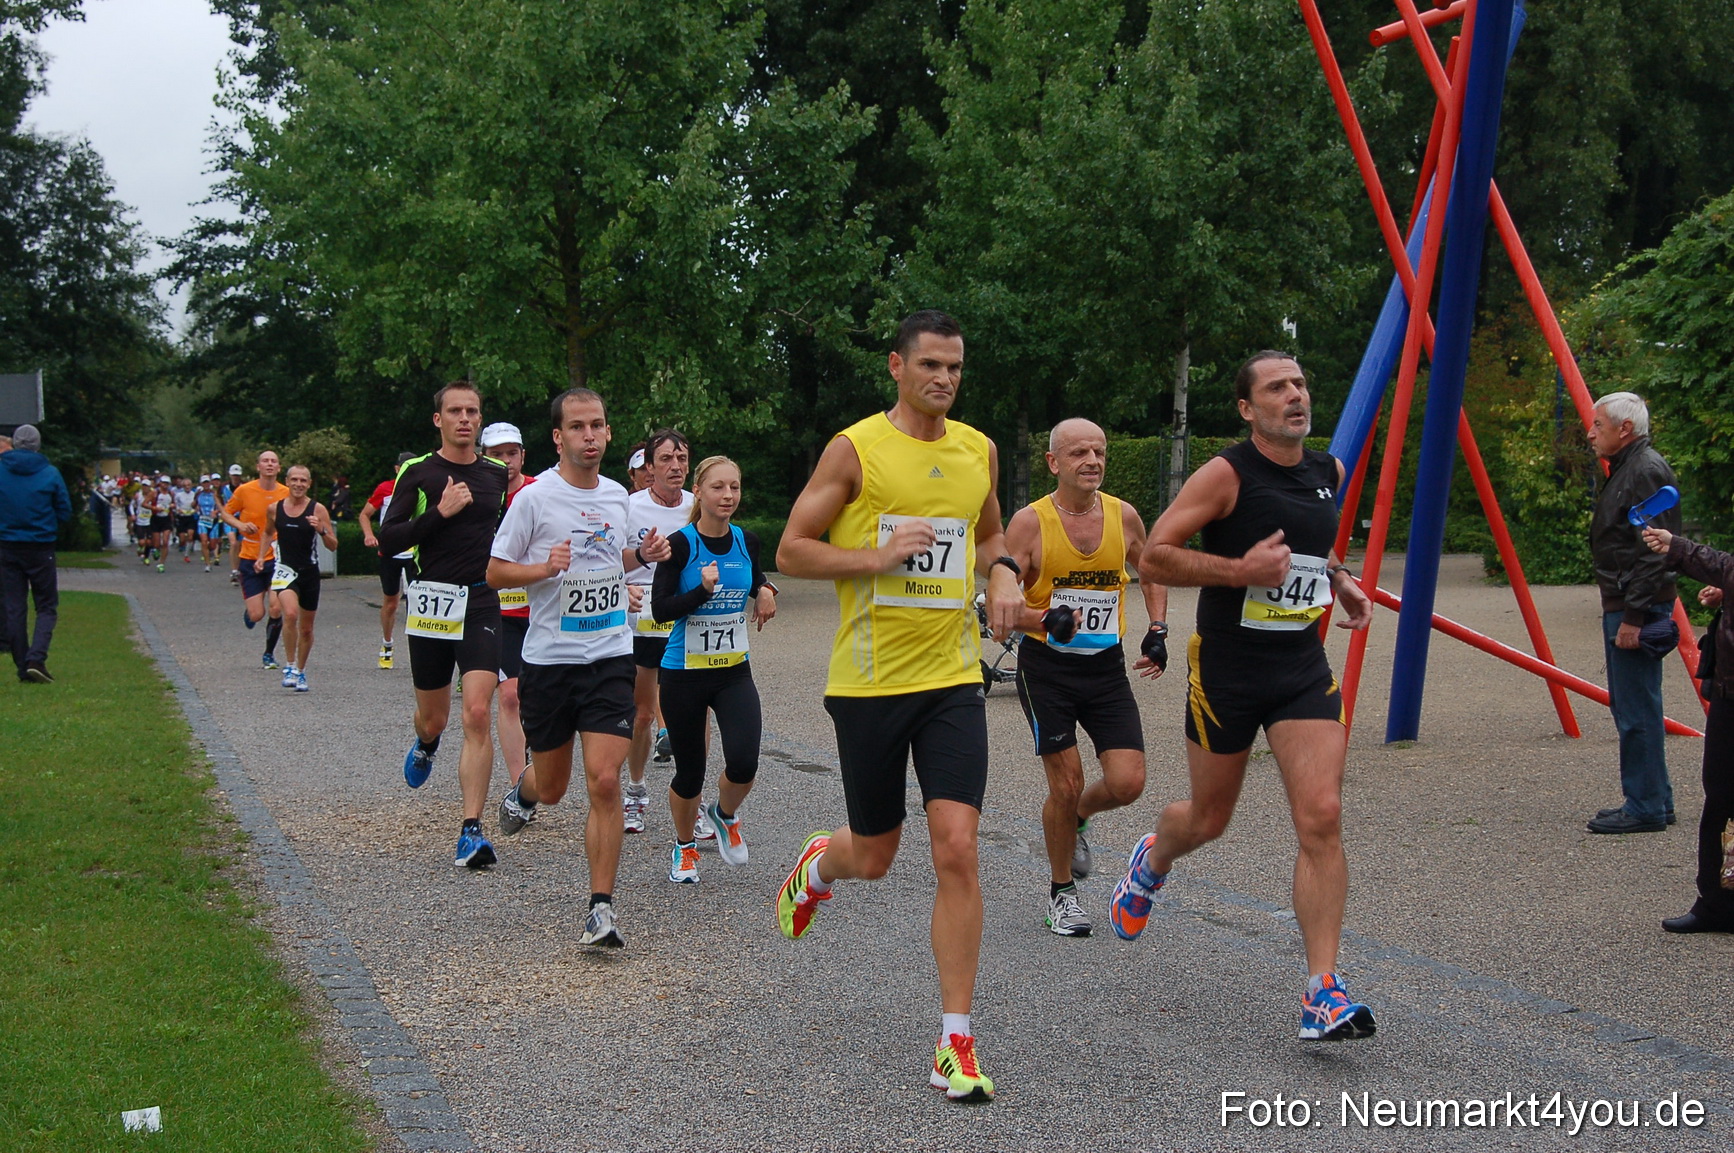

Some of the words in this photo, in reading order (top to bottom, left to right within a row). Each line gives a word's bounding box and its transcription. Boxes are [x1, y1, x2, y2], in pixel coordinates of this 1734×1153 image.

[563, 579, 587, 587] PARTL
[588, 575, 618, 586] Neumarkt
[905, 581, 942, 595] Marco
[500, 595, 526, 603] ndreas
[568, 583, 620, 614] 2536
[1053, 593, 1077, 602] PARTL
[1078, 596, 1111, 604] Neumarkt
[417, 594, 455, 617] 317
[417, 619, 449, 631] Andreas
[578, 616, 611, 630] Michael
[686, 620, 709, 628] PARTL
[710, 618, 738, 627] Neumarkt
[700, 628, 735, 652] 171
[708, 657, 728, 666] Lena
